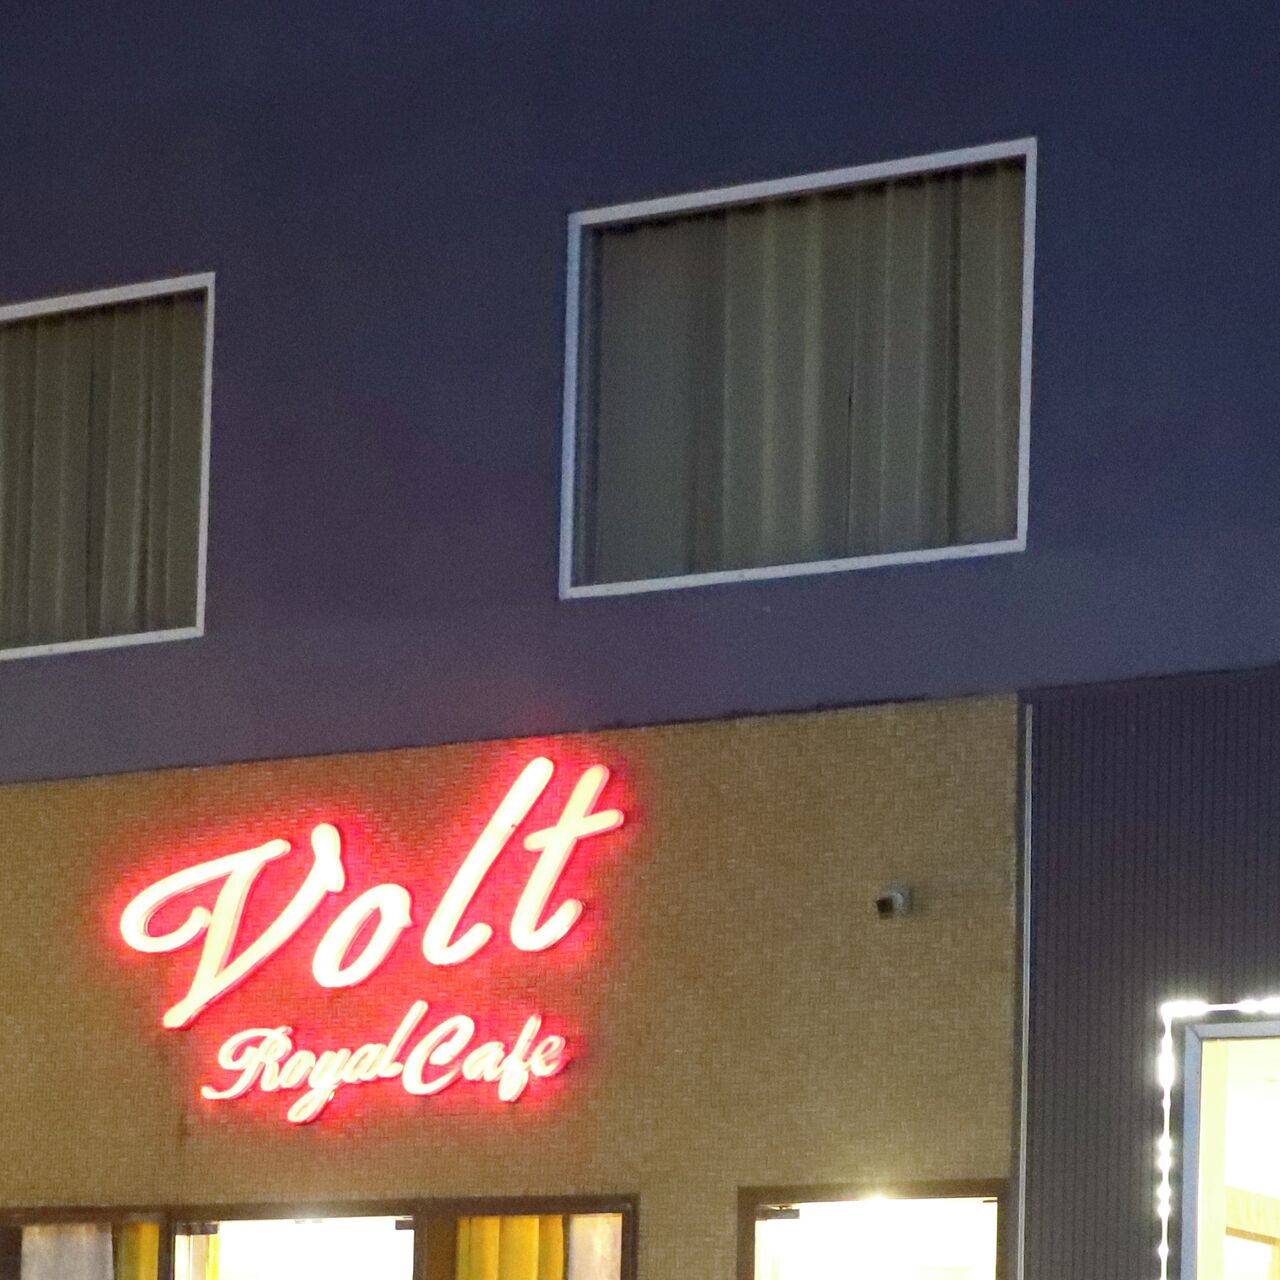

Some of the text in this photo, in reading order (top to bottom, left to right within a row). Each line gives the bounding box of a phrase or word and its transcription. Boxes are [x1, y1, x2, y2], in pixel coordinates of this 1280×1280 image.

[120, 757, 624, 1029] Volt
[201, 1000, 568, 1123] Royal Cafe
